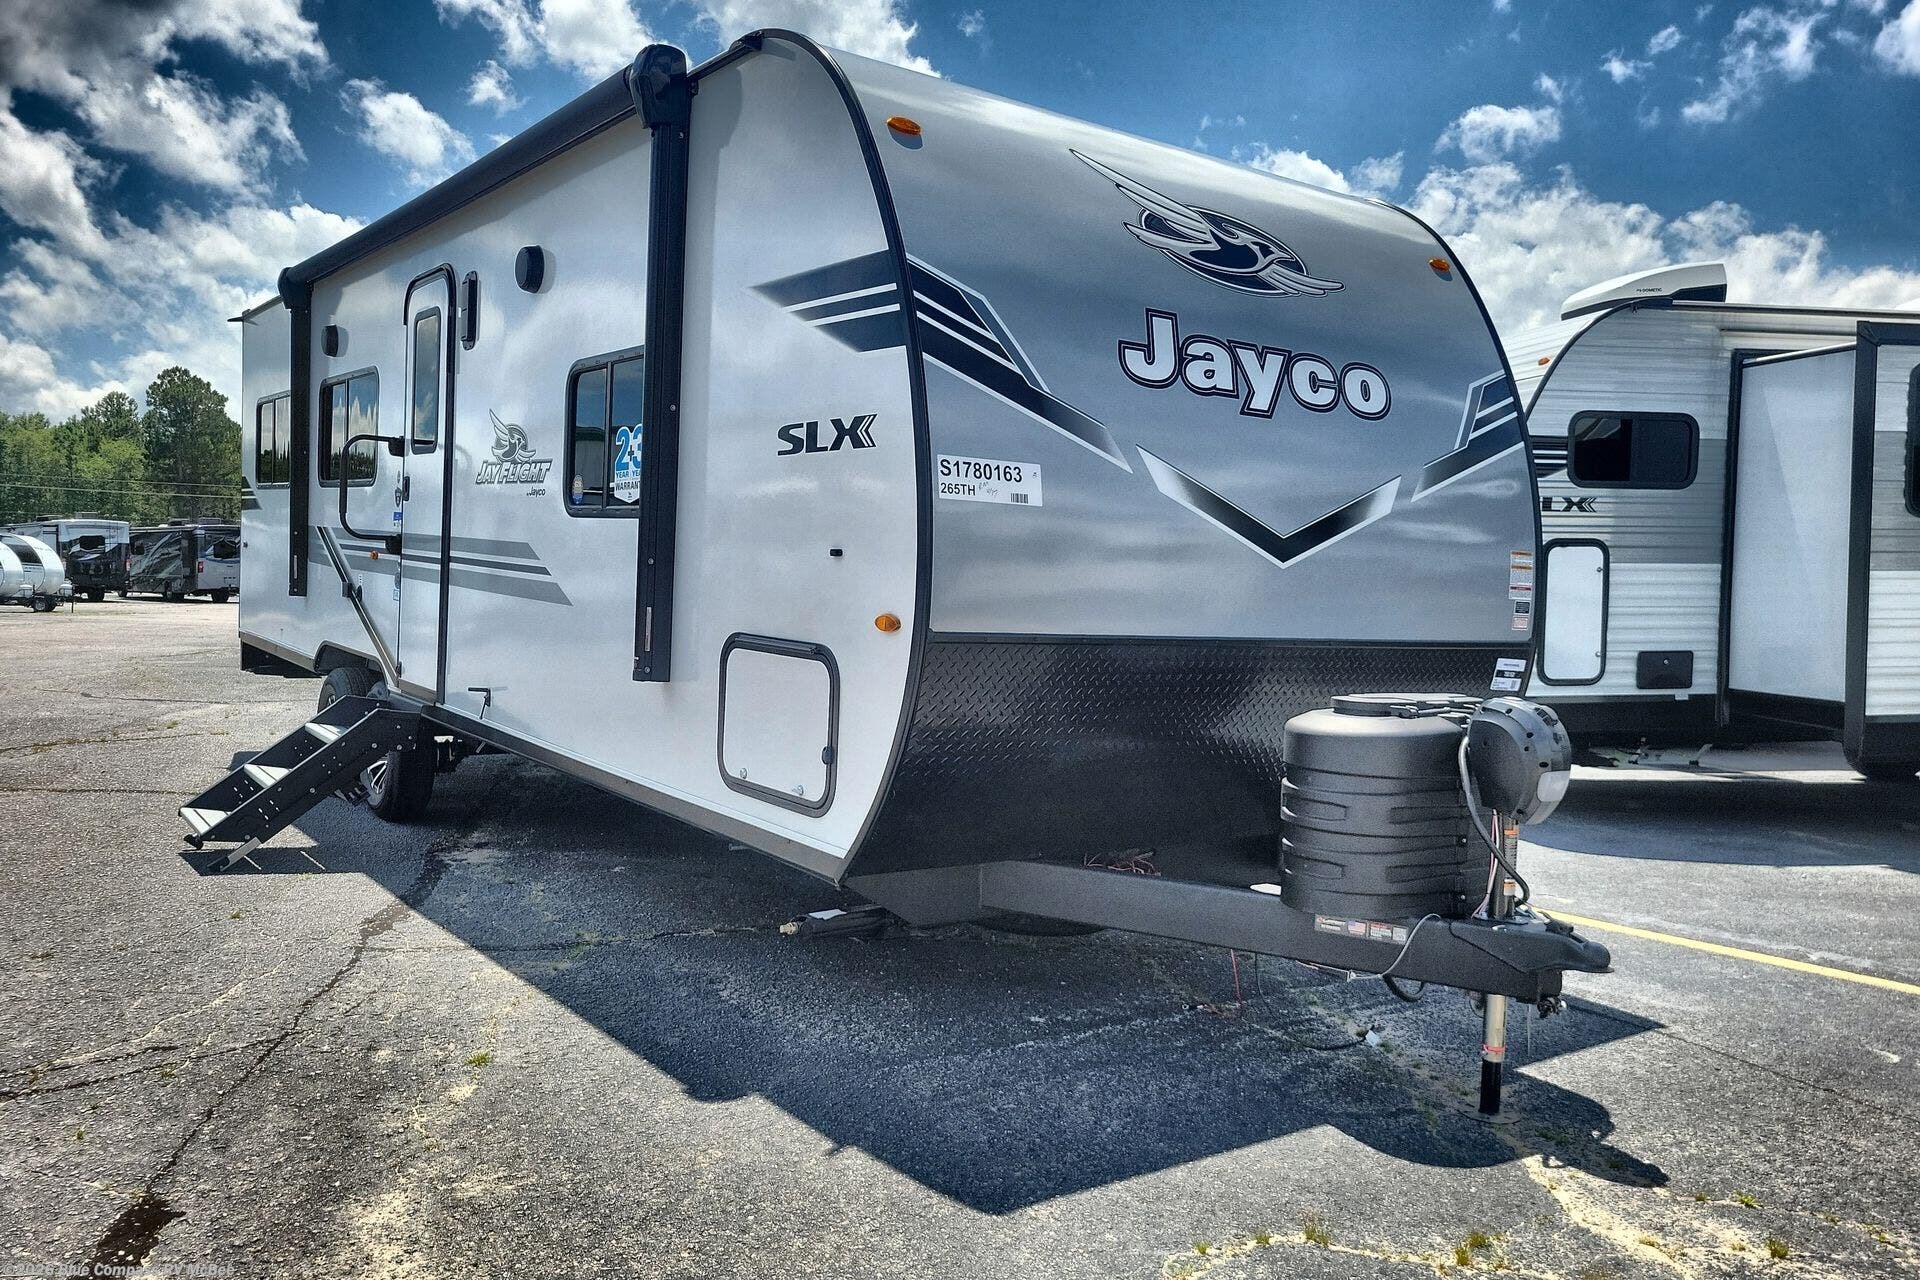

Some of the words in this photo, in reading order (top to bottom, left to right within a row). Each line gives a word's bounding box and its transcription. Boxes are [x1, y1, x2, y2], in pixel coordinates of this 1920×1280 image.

[1118, 307, 1391, 421] Jayco
[777, 413, 878, 456] SLX
[616, 471, 629, 479] YEAR
[940, 459, 1022, 482] S1780163
[615, 481, 640, 491] WARRAN
[940, 482, 976, 496] 265TH
[1541, 497, 1597, 512] LX
